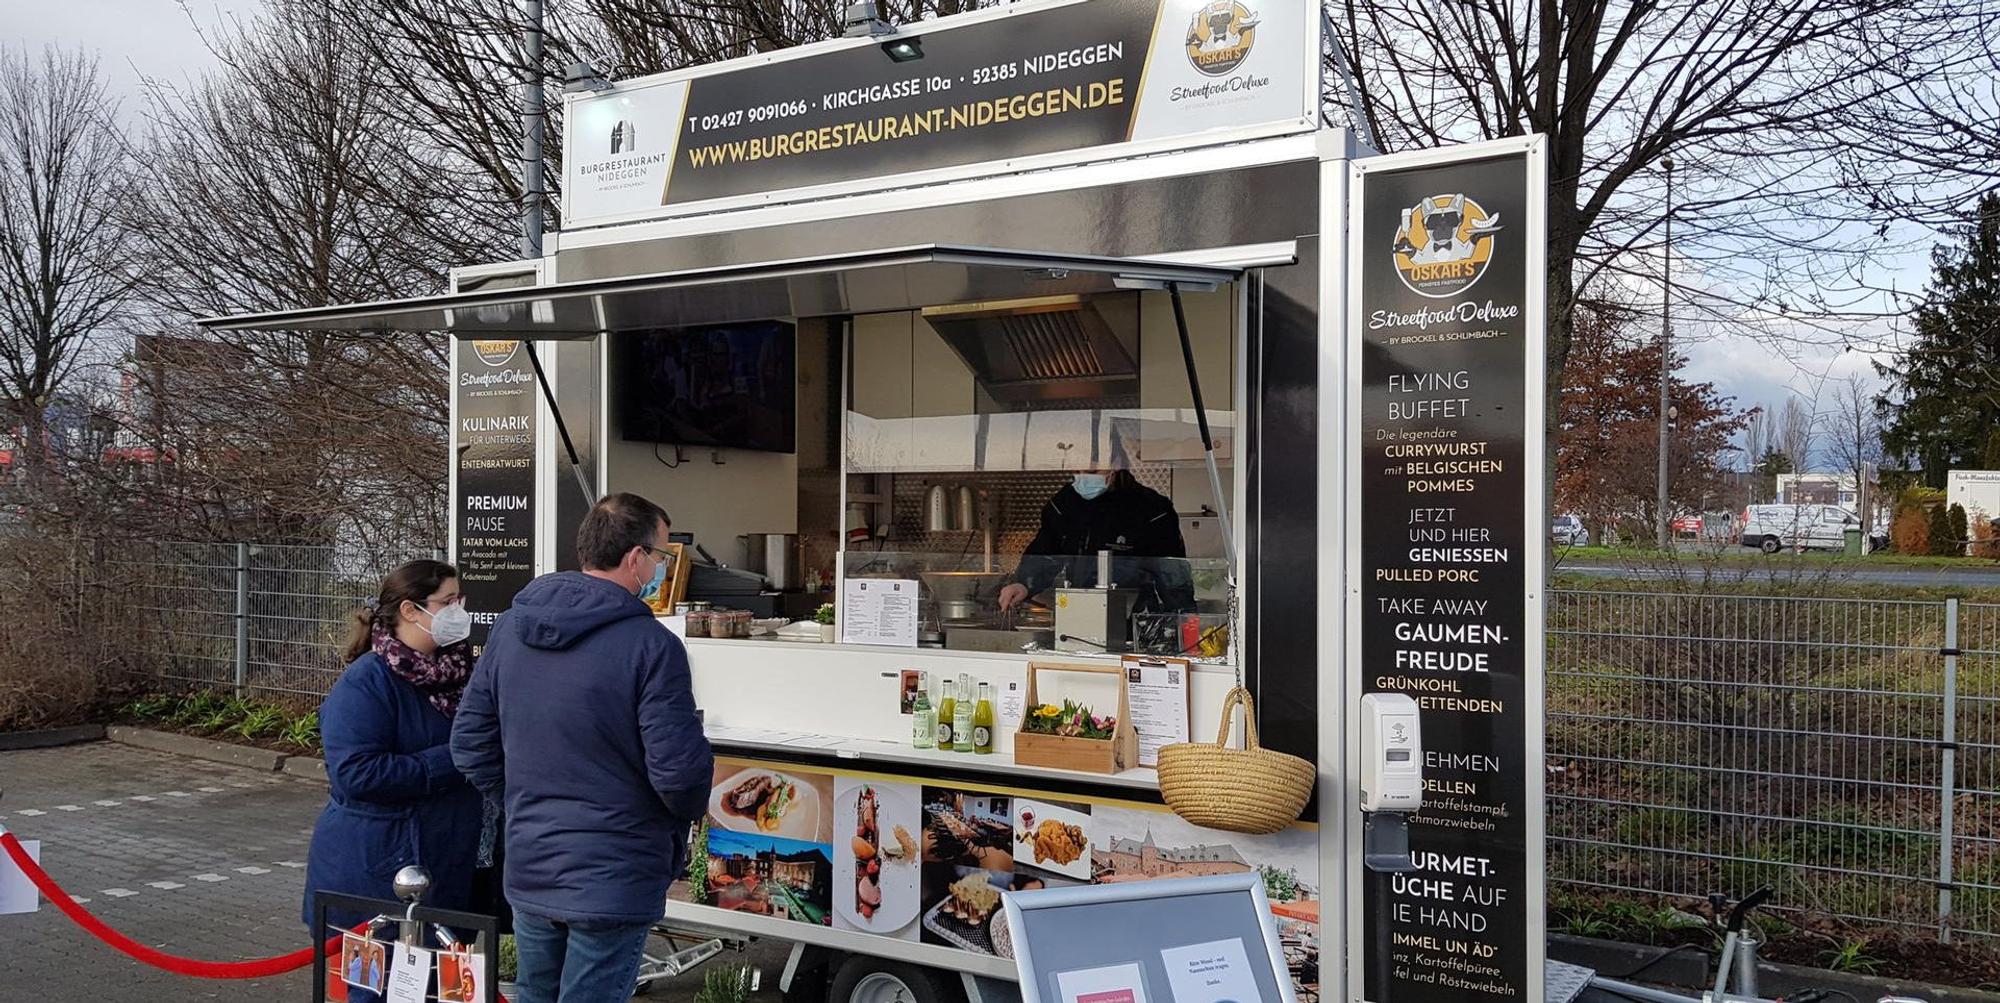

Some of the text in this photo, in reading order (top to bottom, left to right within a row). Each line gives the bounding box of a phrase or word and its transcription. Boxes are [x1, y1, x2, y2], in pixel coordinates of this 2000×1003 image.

[1199, 47, 1241, 65] OSKAR'S
[689, 41, 1123, 133] T 02427 9091066 KIRCHGASSE 10a 52385 NIDEGGEN
[1170, 75, 1269, 101] Streetfood Deluxe
[689, 78, 1125, 169] WWW.BURGRESTAURANT-NIDEGGEN.DE
[581, 153, 666, 175] BURGRESTAURANT
[598, 167, 647, 182] NIDEGGEN
[1411, 262, 1475, 281] OSKAR'S
[1368, 300, 1518, 332] Streetfood Deluxe
[1389, 337, 1400, 345] BY
[1446, 330, 1498, 341] SCHLIMBACH
[1388, 371, 1470, 393] FLYING
[1389, 399, 1470, 421] BUFFET
[462, 415, 529, 432] KULINARIK
[485, 434, 531, 445] UNTERWEGS
[1376, 428, 1457, 443] Die legendäre
[1385, 442, 1487, 458] CURRYWURST
[461, 458, 531, 469] ENTENBRATWURST
[1384, 460, 1503, 476] mit BELGISCHEN
[1408, 480, 1475, 493] POMMES
[467, 495, 528, 511] PREMIUM
[467, 516, 505, 532] PAUSE
[1408, 508, 1456, 525] JETZT
[462, 537, 529, 547] TATAR VOM LACHS
[1409, 528, 1490, 542] UND HIER
[471, 550, 497, 558] Avocado
[1409, 548, 1508, 563] GENIESSEN
[494, 561, 506, 570] und
[507, 560, 530, 570] kleinem
[1376, 569, 1480, 583] PULLED PORC
[1377, 597, 1488, 616] TAKE AWAY
[1395, 622, 1509, 644] GAUMEN-
[1395, 650, 1489, 673] FREUDE
[1376, 675, 1462, 693] GRÜNKOHL
[1421, 797, 1509, 817] artoffelstampf,
[1408, 812, 1495, 831] chmorzwiebeln
[1411, 850, 1496, 877] URMET-
[1392, 871, 1507, 907] ÜCHE AUF
[1393, 902, 1487, 932] IE HAND
[1393, 932, 1441, 951] IMMEL
[1445, 939, 1468, 954] UN
[1415, 953, 1503, 979] Kartoffelpüree,
[1413, 971, 1435, 984] und
[1439, 973, 1515, 996] Röstzwiebeln
